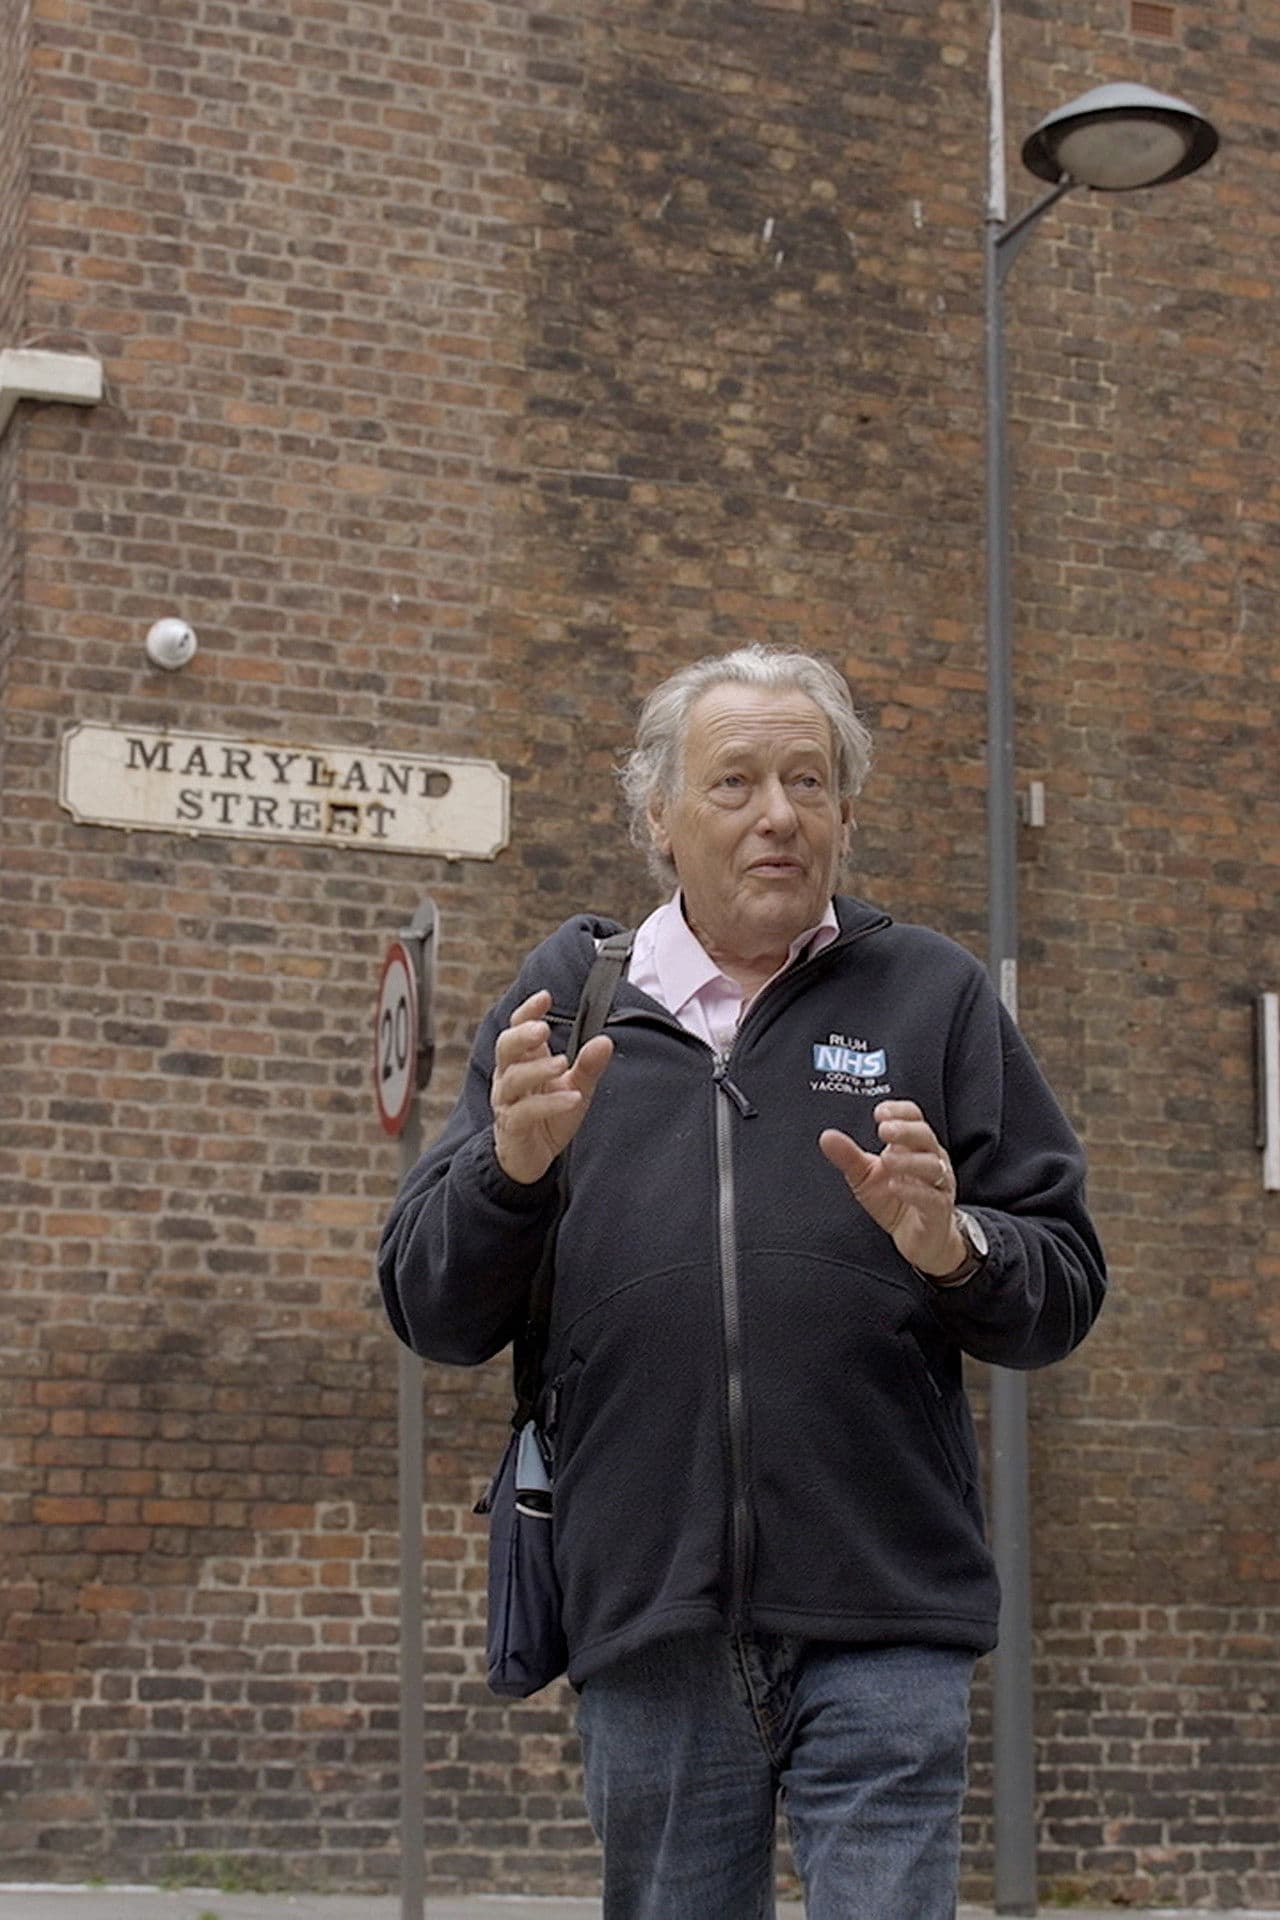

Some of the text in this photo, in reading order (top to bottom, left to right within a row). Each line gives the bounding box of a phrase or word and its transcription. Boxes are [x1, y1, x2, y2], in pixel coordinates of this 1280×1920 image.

[125, 738, 453, 799] MARYLAND
[176, 788, 396, 838] STREET
[381, 995, 409, 1083] 20
[815, 1045, 886, 1077] NHS
